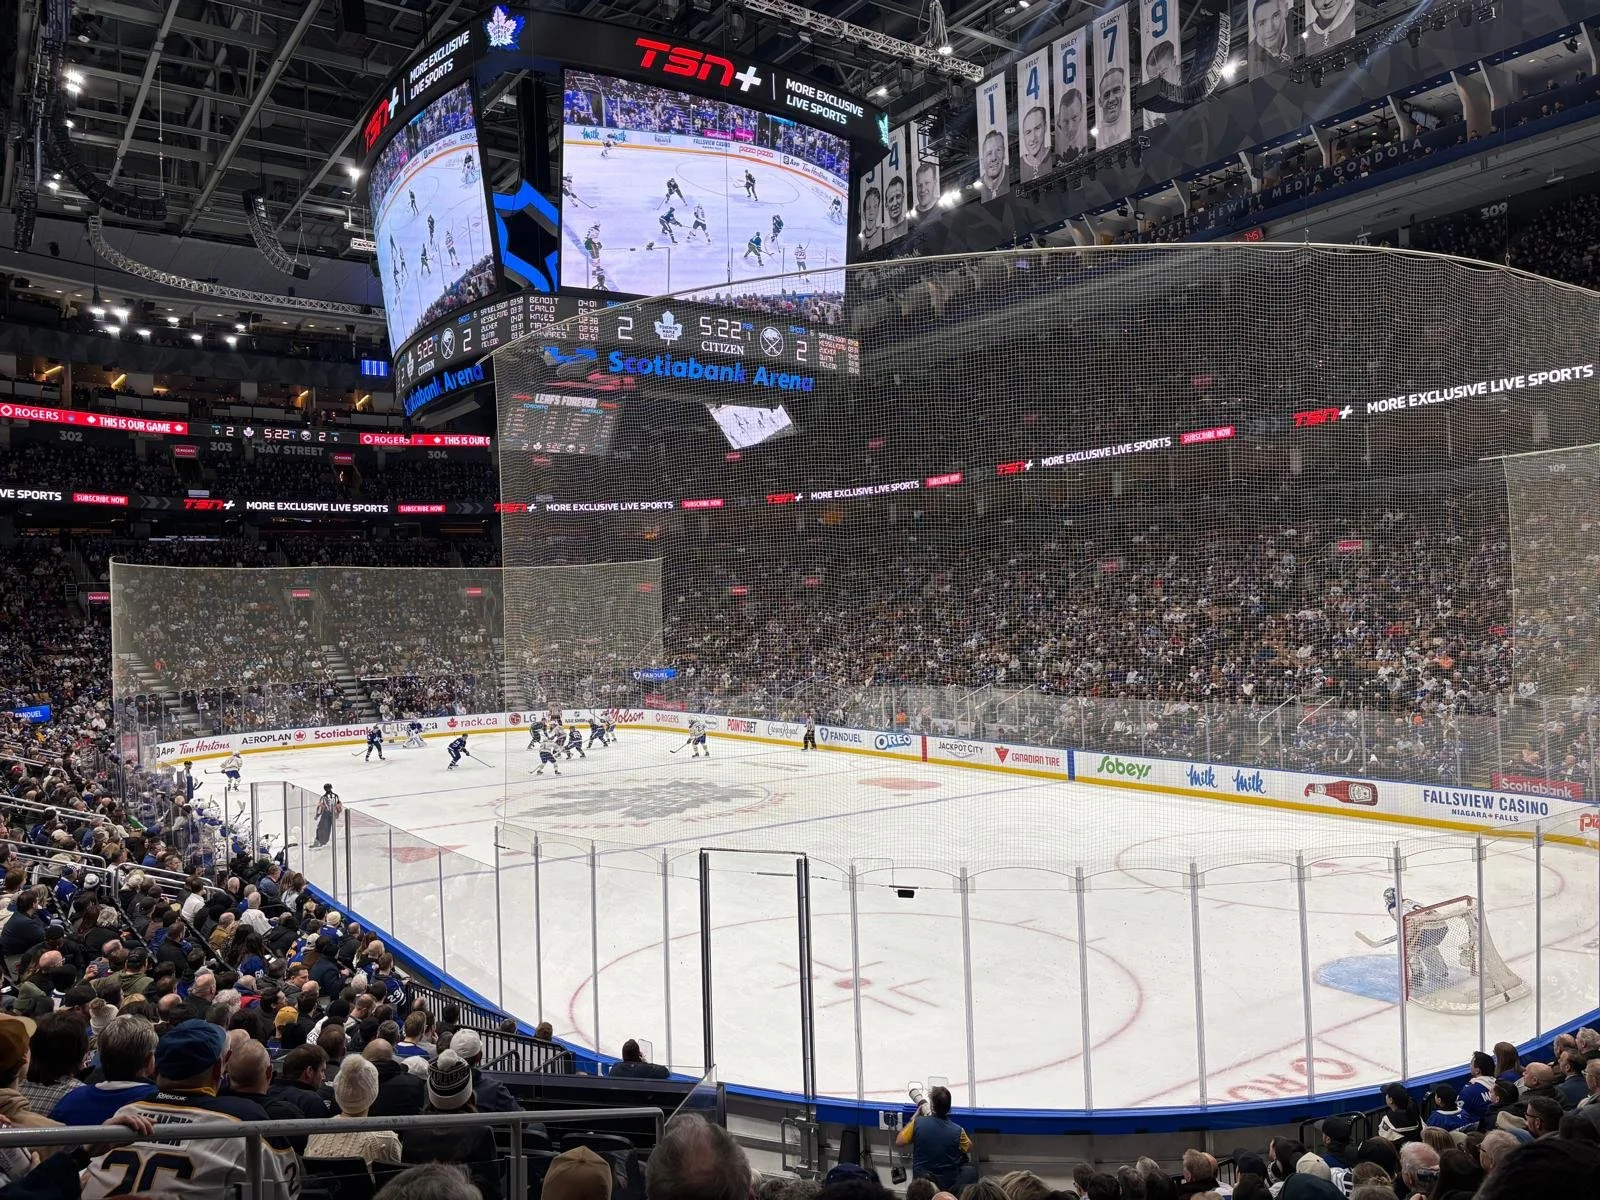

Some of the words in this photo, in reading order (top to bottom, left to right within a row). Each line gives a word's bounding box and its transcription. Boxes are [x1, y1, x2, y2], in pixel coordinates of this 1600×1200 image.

[1100, 14, 1120, 30] CLANCY
[1152, 0, 1168, 38] 9
[1103, 24, 1117, 63] 7
[409, 59, 428, 84] MORE
[428, 30, 470, 68] EXCLUSIVE
[1062, 47, 1077, 85] 6
[410, 81, 424, 100] LIVE
[424, 58, 454, 91] SPORTS
[1026, 66, 1040, 100] 4
[786, 78, 815, 99] MORE
[816, 90, 864, 117] EXCLUSIVE
[786, 94, 809, 112] LIVE
[809, 99, 847, 125] SPORTS
[989, 93, 996, 125] 1
[889, 141, 899, 171] 4
[1151, 217, 1199, 239] FOSTER
[1208, 193, 1261, 220] HEWITT
[1272, 174, 1322, 199] MEDIA
[1333, 138, 1422, 177] GONDOLA
[1480, 201, 1509, 220] 309
[529, 296, 559, 305] BENOIT
[529, 305, 555, 313] CARLO
[617, 316, 632, 340] 2
[700, 316, 742, 340] 5:22
[463, 328, 472, 352] 2
[701, 341, 744, 355] CITIZEN
[796, 341, 807, 362] 2
[443, 363, 485, 392] Arena
[608, 350, 747, 383] Scotiabank
[753, 366, 814, 392] Arena
[1366, 397, 1406, 414] MORE
[1409, 381, 1487, 408] EXCLUSIVE
[1491, 375, 1525, 393] LIVE
[1528, 364, 1594, 387] SPORTS
[535, 393, 561, 406] LEAFS
[561, 395, 598, 409] FOREVER
[15, 407, 59, 421] ROGERS
[99, 417, 118, 428] THIS
[119, 418, 126, 428] IS
[127, 420, 146, 431] OUR
[146, 422, 171, 433] GAME
[59, 430, 83, 442] 302
[226, 426, 234, 437] 2
[264, 428, 289, 439] 5:22
[318, 432, 326, 442] 2
[375, 436, 410, 445] ROGERS
[444, 436, 460, 445] THIS
[461, 436, 467, 445] IS
[469, 436, 484, 445] OUR
[1183, 430, 1215, 443] SUBSCRIBE
[1216, 427, 1231, 438] NOW
[210, 441, 233, 452] 303
[258, 444, 280, 454] BAY
[283, 445, 324, 457] STREET
[1041, 455, 1064, 467] MORE
[1066, 447, 1111, 463] EXCLUSIVE
[1112, 443, 1132, 455] LIVE
[1133, 437, 1171, 452] SPORTS
[428, 451, 448, 460] 304
[17, 490, 62, 501] SPORTS
[811, 490, 832, 500] MORE
[834, 486, 873, 498] EXCLUSIVE
[874, 484, 889, 493] LIVE
[891, 480, 919, 491] SPORTS
[76, 494, 109, 503] SUBSCRIBE
[110, 496, 125, 504] NOW
[546, 503, 571, 512] MORE
[573, 502, 619, 512] EXCLUSIVE
[620, 502, 638, 511] LIVE
[640, 501, 674, 510] SPORTS
[246, 502, 275, 511] MORE
[277, 502, 328, 512] EXCLUSIVE
[330, 503, 350, 512] LIVE
[352, 503, 388, 513] SPORTS
[460, 716, 498, 728] rack.ca
[524, 714, 537, 723] LG
[608, 708, 645, 725] Molson
[314, 726, 372, 740] Scotiabank
[727, 718, 757, 734] POINTSBET
[242, 733, 292, 745] AEROPLAN
[830, 731, 862, 743] FANDUEL
[875, 732, 912, 750] OREO
[179, 742, 195, 755] Tim
[195, 740, 230, 754] Hortons
[938, 741, 966, 753] JACKPOT
[967, 744, 984, 754] CITY
[1011, 752, 1044, 766] CANADIAN
[1045, 755, 1060, 767] TIRE
[1097, 755, 1151, 780] Sobeys
[1501, 777, 1572, 799] Scotiabank
[1423, 789, 1494, 810] FALLSVIEW
[1499, 797, 1549, 816] CASINO
[1451, 808, 1487, 819] NIAGARA
[1494, 813, 1519, 822] FALLS
